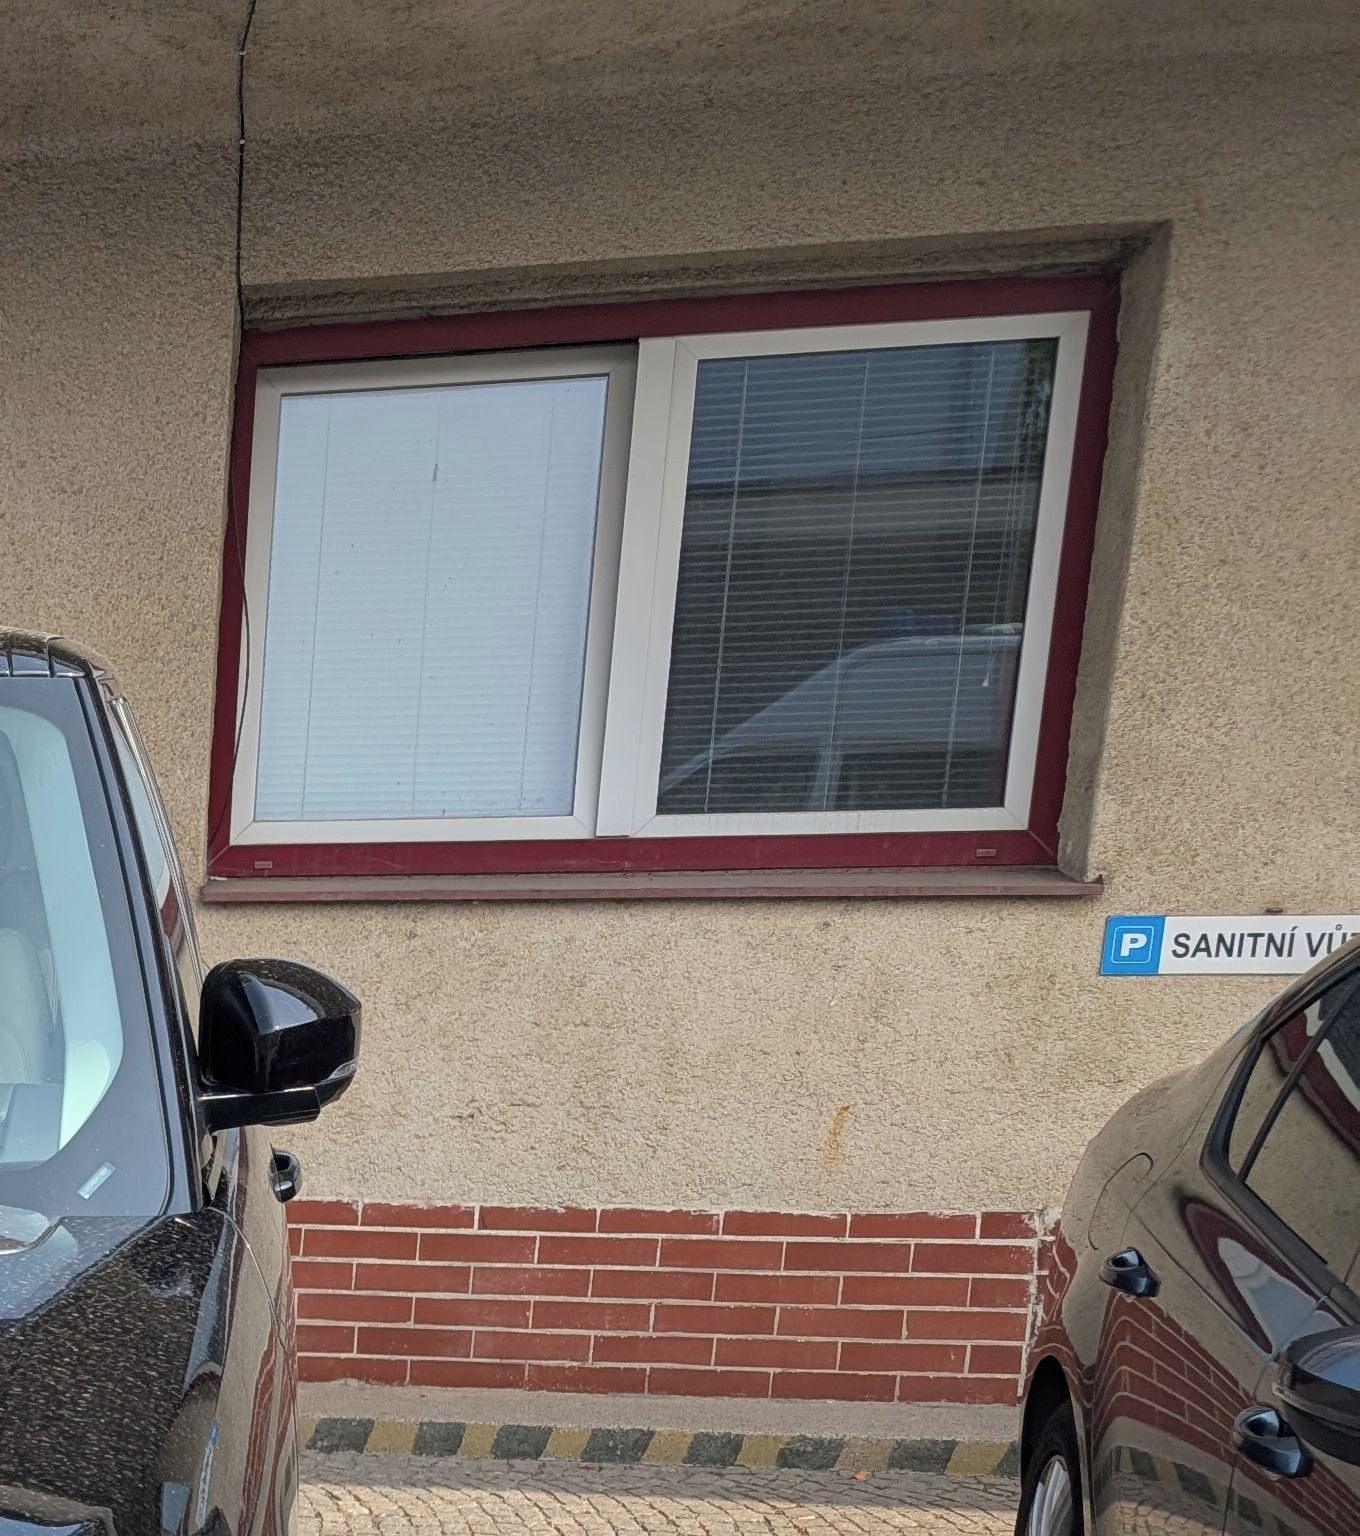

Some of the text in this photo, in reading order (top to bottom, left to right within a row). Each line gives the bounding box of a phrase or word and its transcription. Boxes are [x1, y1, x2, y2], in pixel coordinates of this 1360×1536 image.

[1120, 924, 1360, 958] P SANITNÍ VŮ
